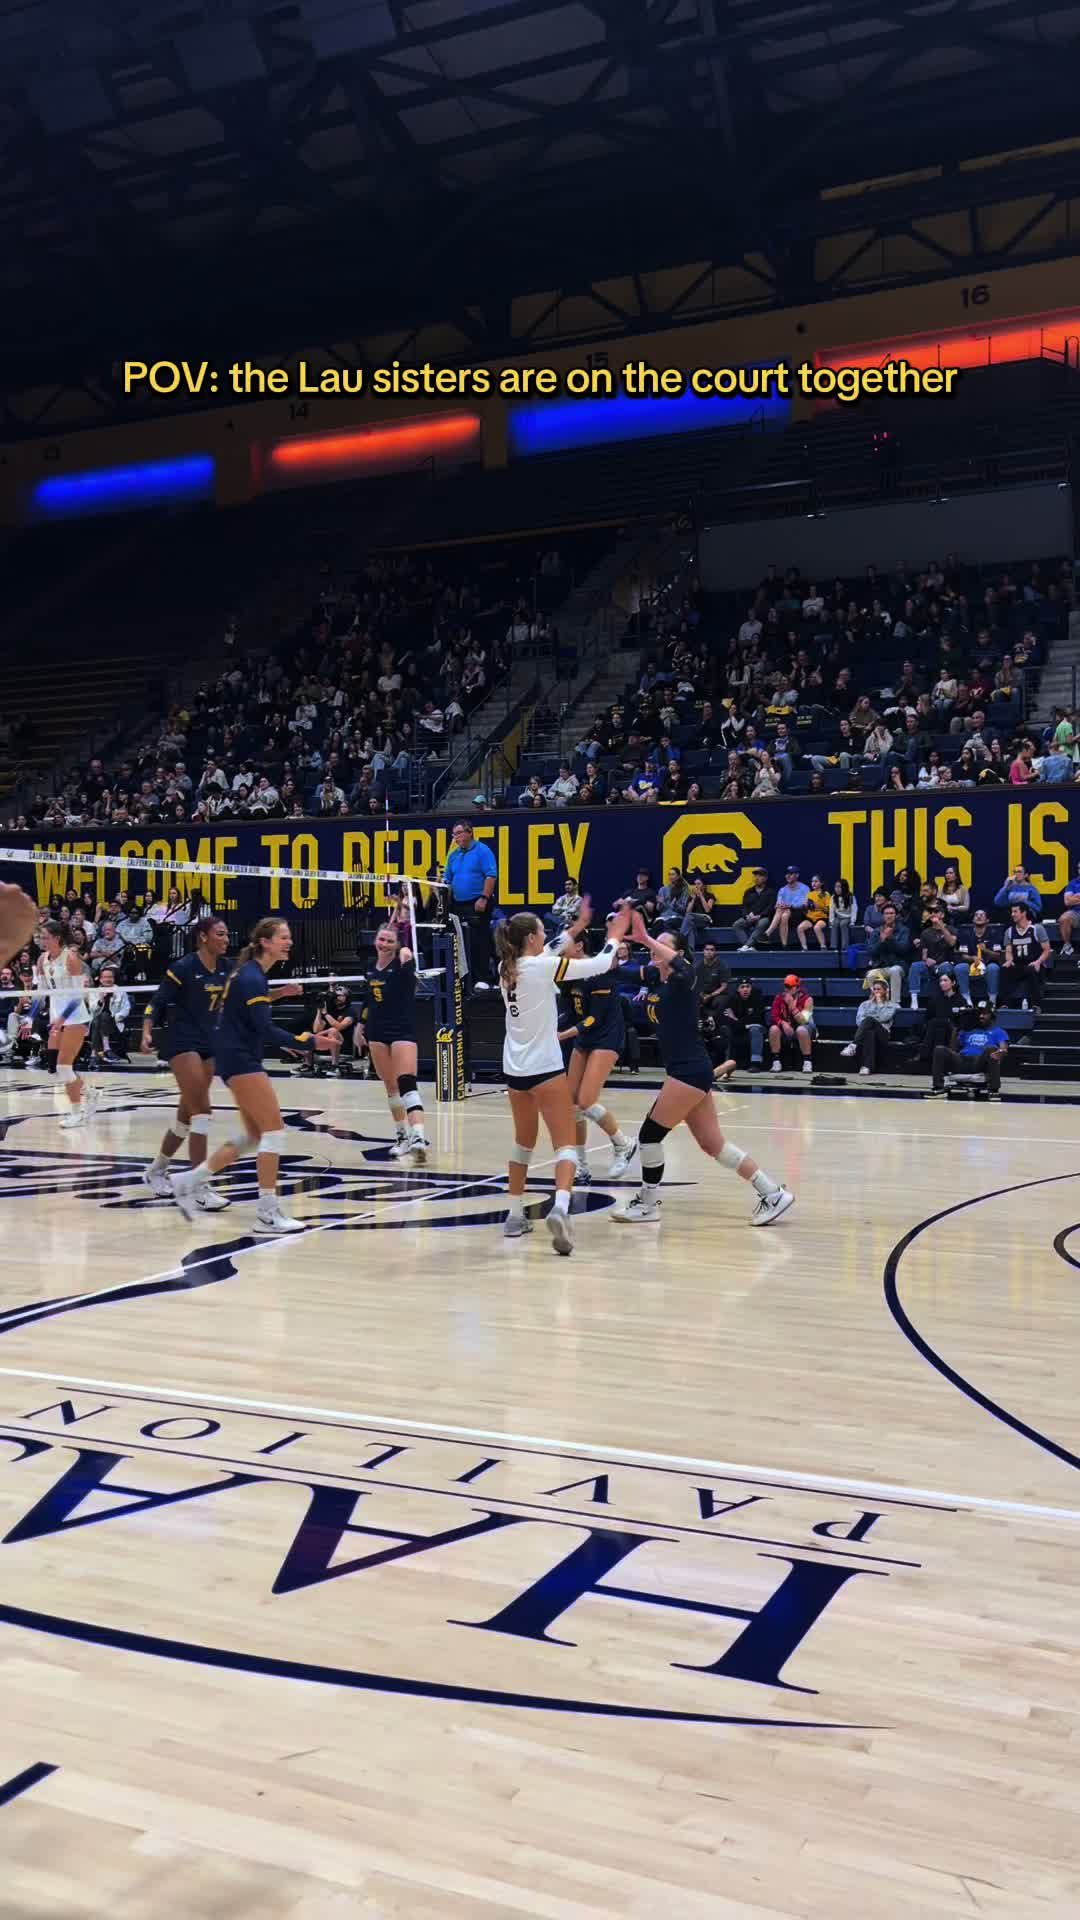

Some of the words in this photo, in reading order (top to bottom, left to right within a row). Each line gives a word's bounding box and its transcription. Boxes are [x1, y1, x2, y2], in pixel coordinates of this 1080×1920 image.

[960, 284, 989, 308] 16
[33, 835, 238, 909] WELCOME
[260, 833, 319, 910] TO
[342, 822, 591, 908] BERLEY
[828, 805, 972, 895] THIS
[1008, 801, 1069, 896] IS
[1016, 944, 1029, 957] 11
[436, 1027, 454, 1044] Cal
[455, 977, 464, 1024] GOLDEN
[456, 1030, 465, 1100] CALIFORNIA
[18, 1399, 888, 1545] PAVILION
[0, 1434, 890, 1695] HAA
